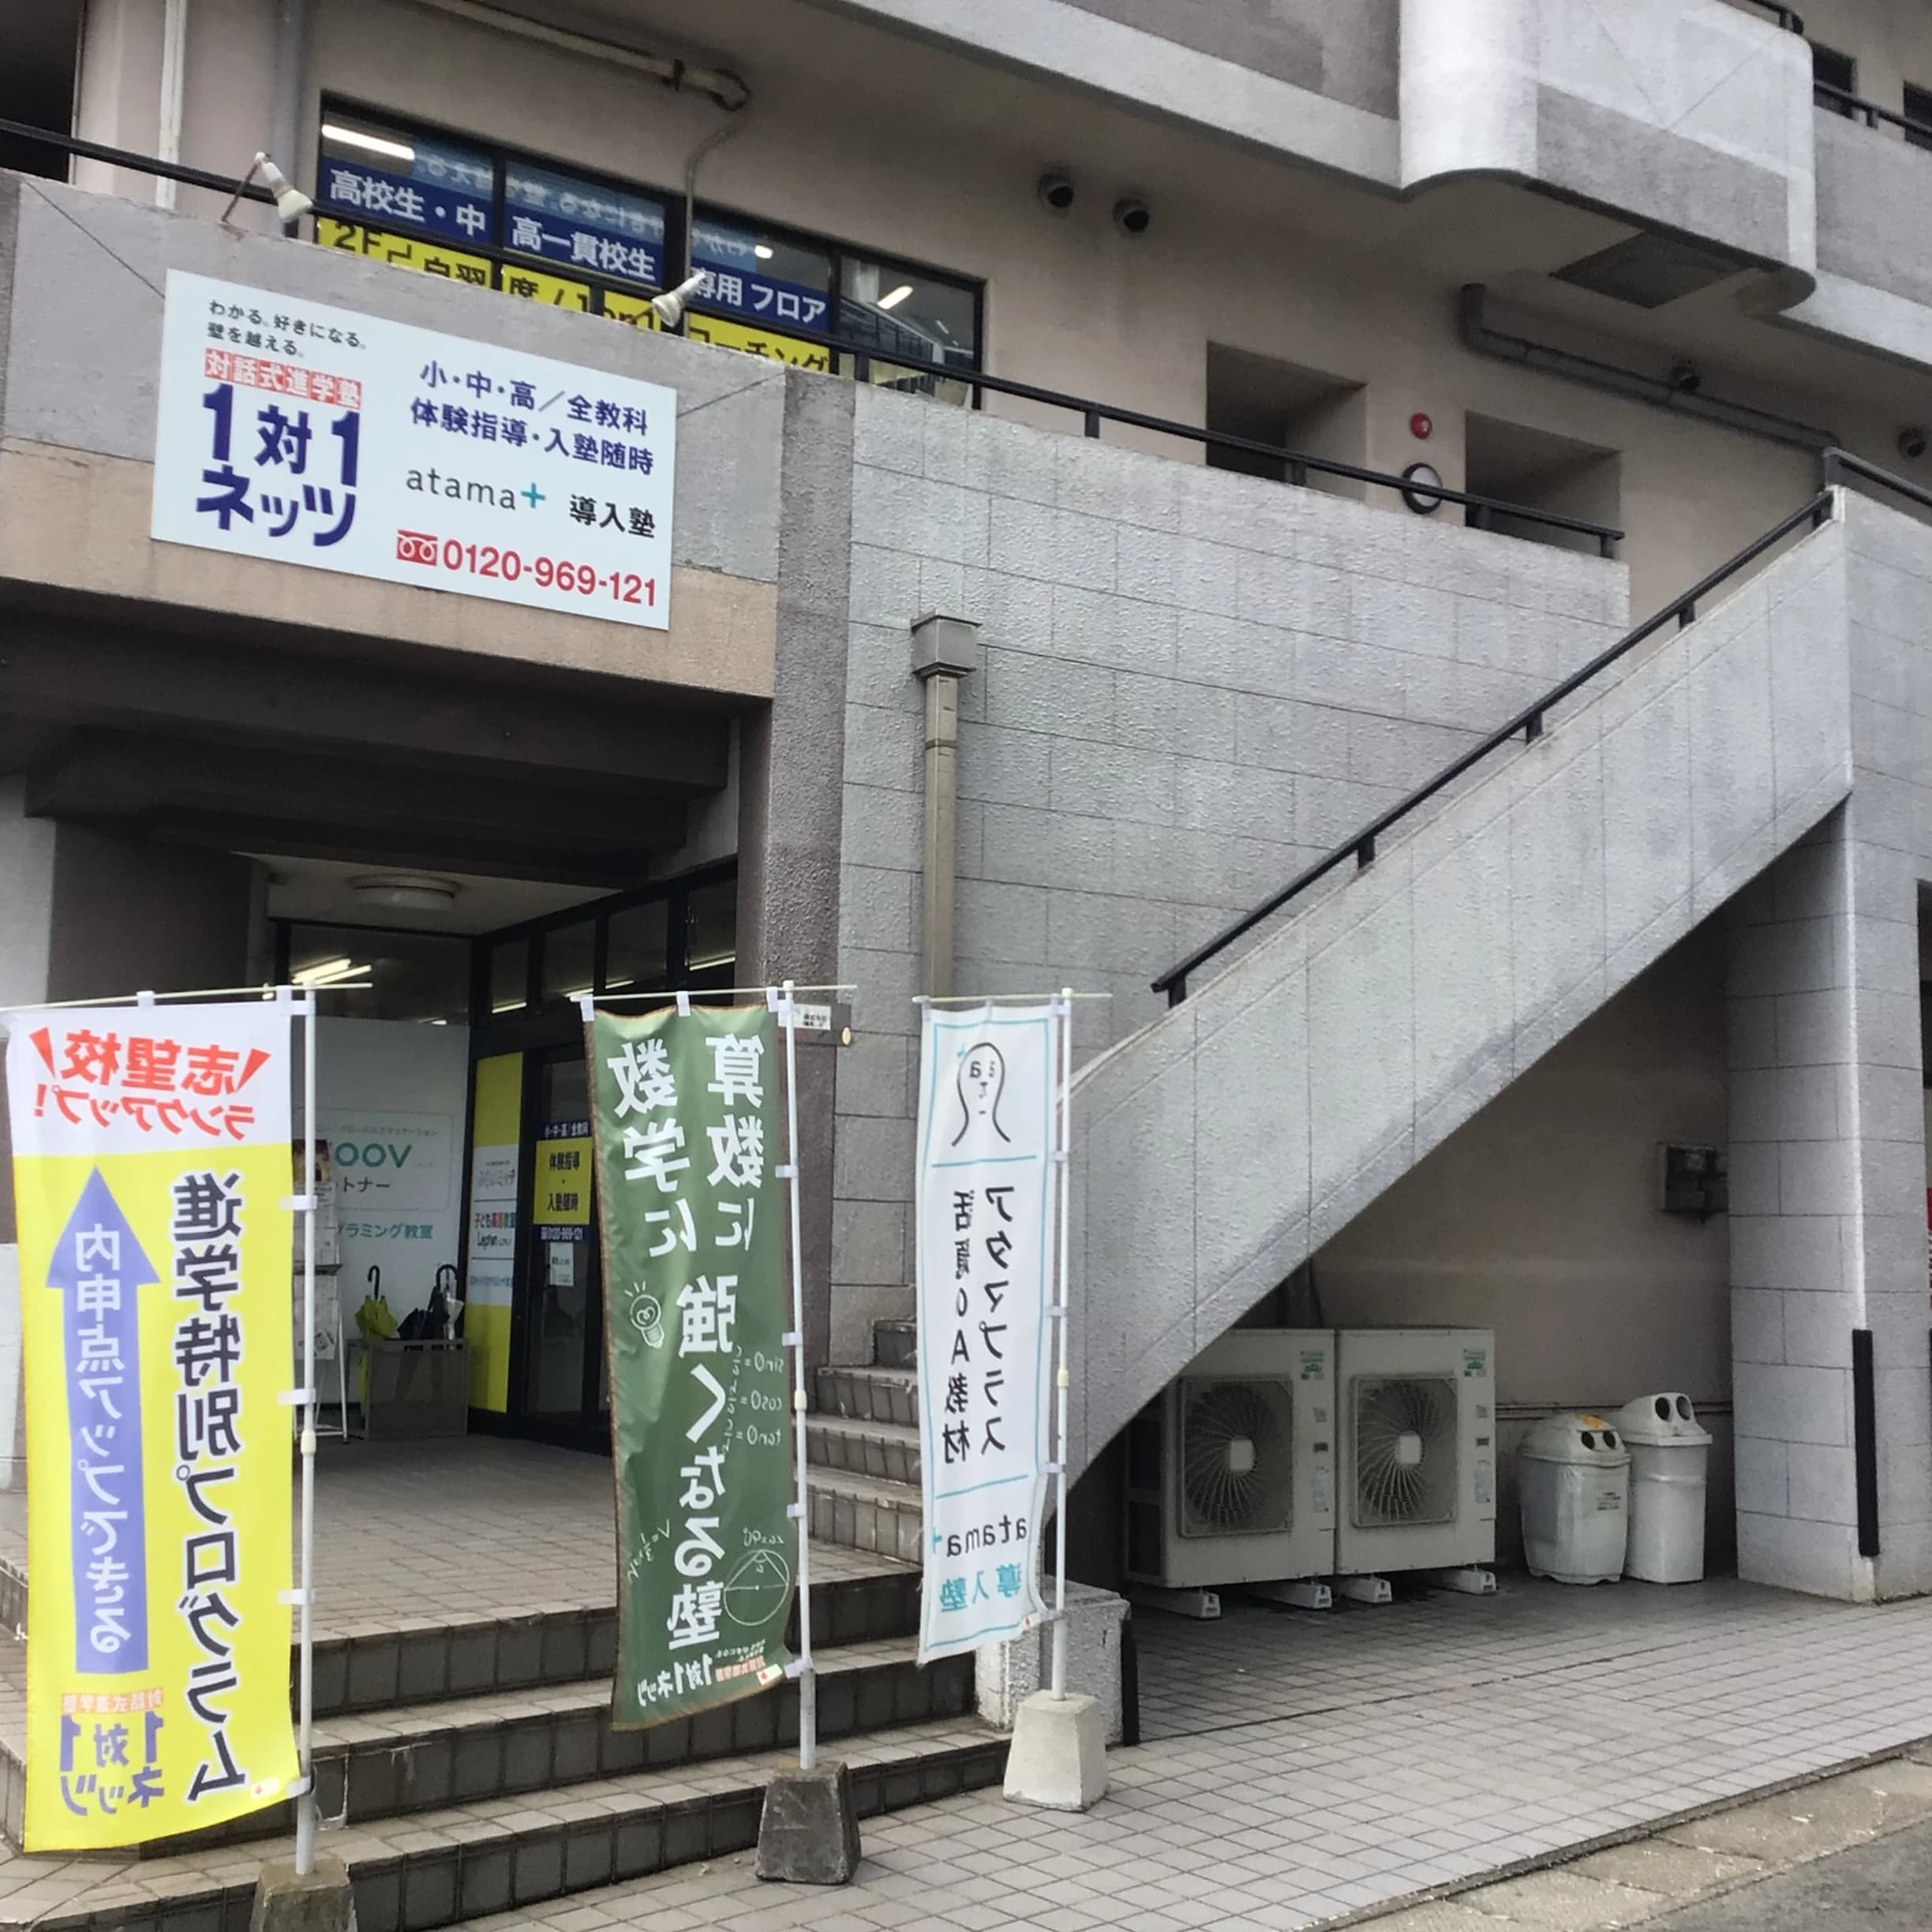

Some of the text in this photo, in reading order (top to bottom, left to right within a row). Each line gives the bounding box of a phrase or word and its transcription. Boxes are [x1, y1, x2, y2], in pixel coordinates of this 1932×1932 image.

[205, 347, 361, 409] 対話式進学塾
[196, 464, 357, 546] ネッツ
[569, 494, 656, 538] 導入塾
[442, 539, 656, 607] 0120-969-121
[335, 1142, 412, 1169] OOV
[337, 1177, 391, 1193] トナー
